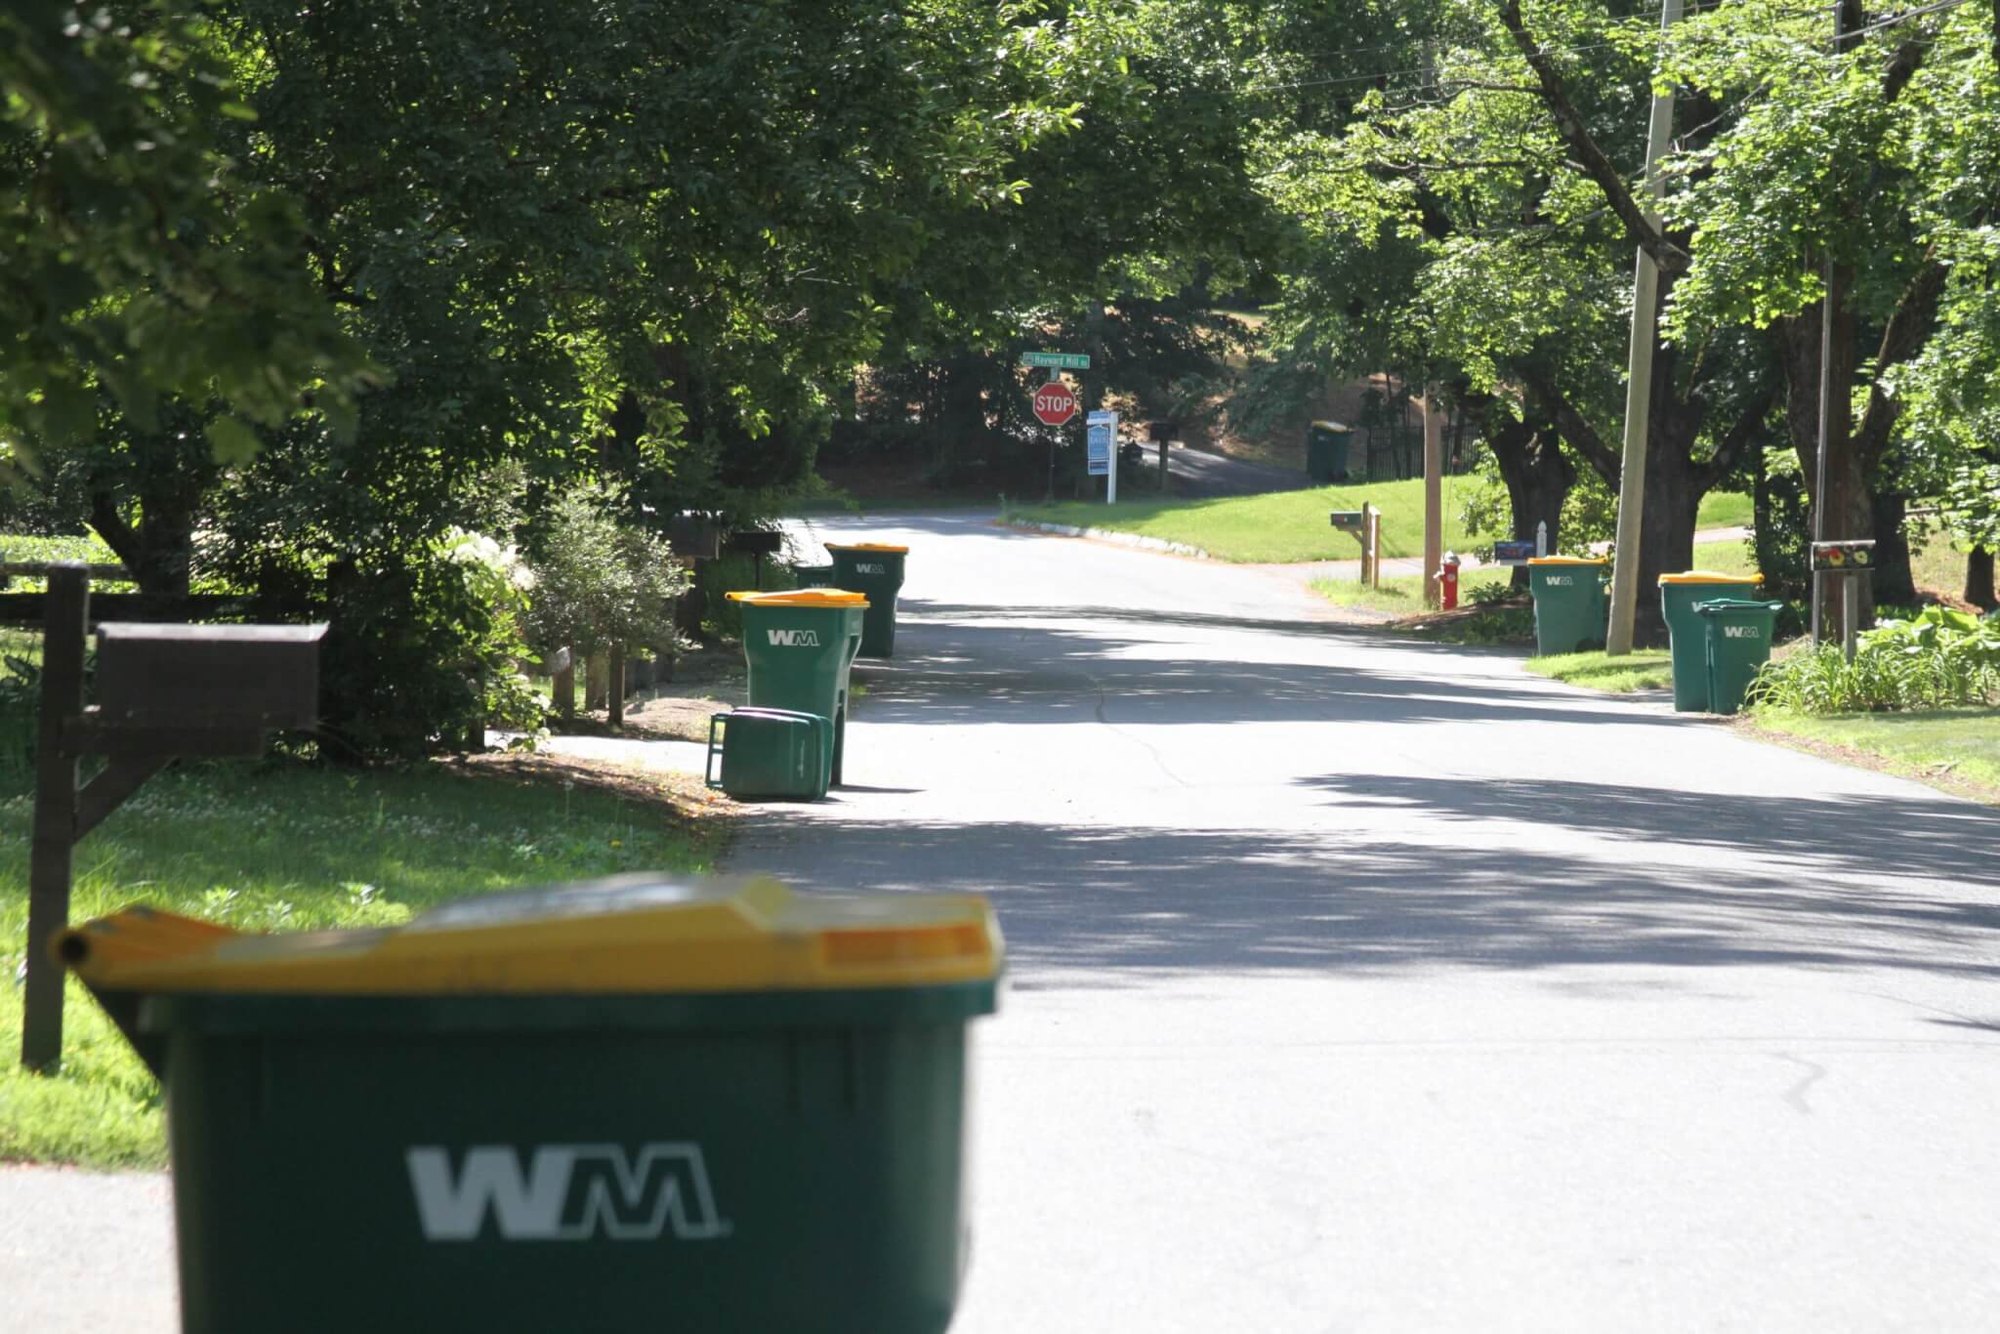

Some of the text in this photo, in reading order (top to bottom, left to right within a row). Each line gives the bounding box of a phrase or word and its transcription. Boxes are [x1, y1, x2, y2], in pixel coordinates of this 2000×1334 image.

[1036, 395, 1072, 412] STOP
[856, 563, 884, 574] WM
[767, 629, 820, 646] WM
[1724, 626, 1759, 638] WM
[404, 1142, 733, 1241] WM
